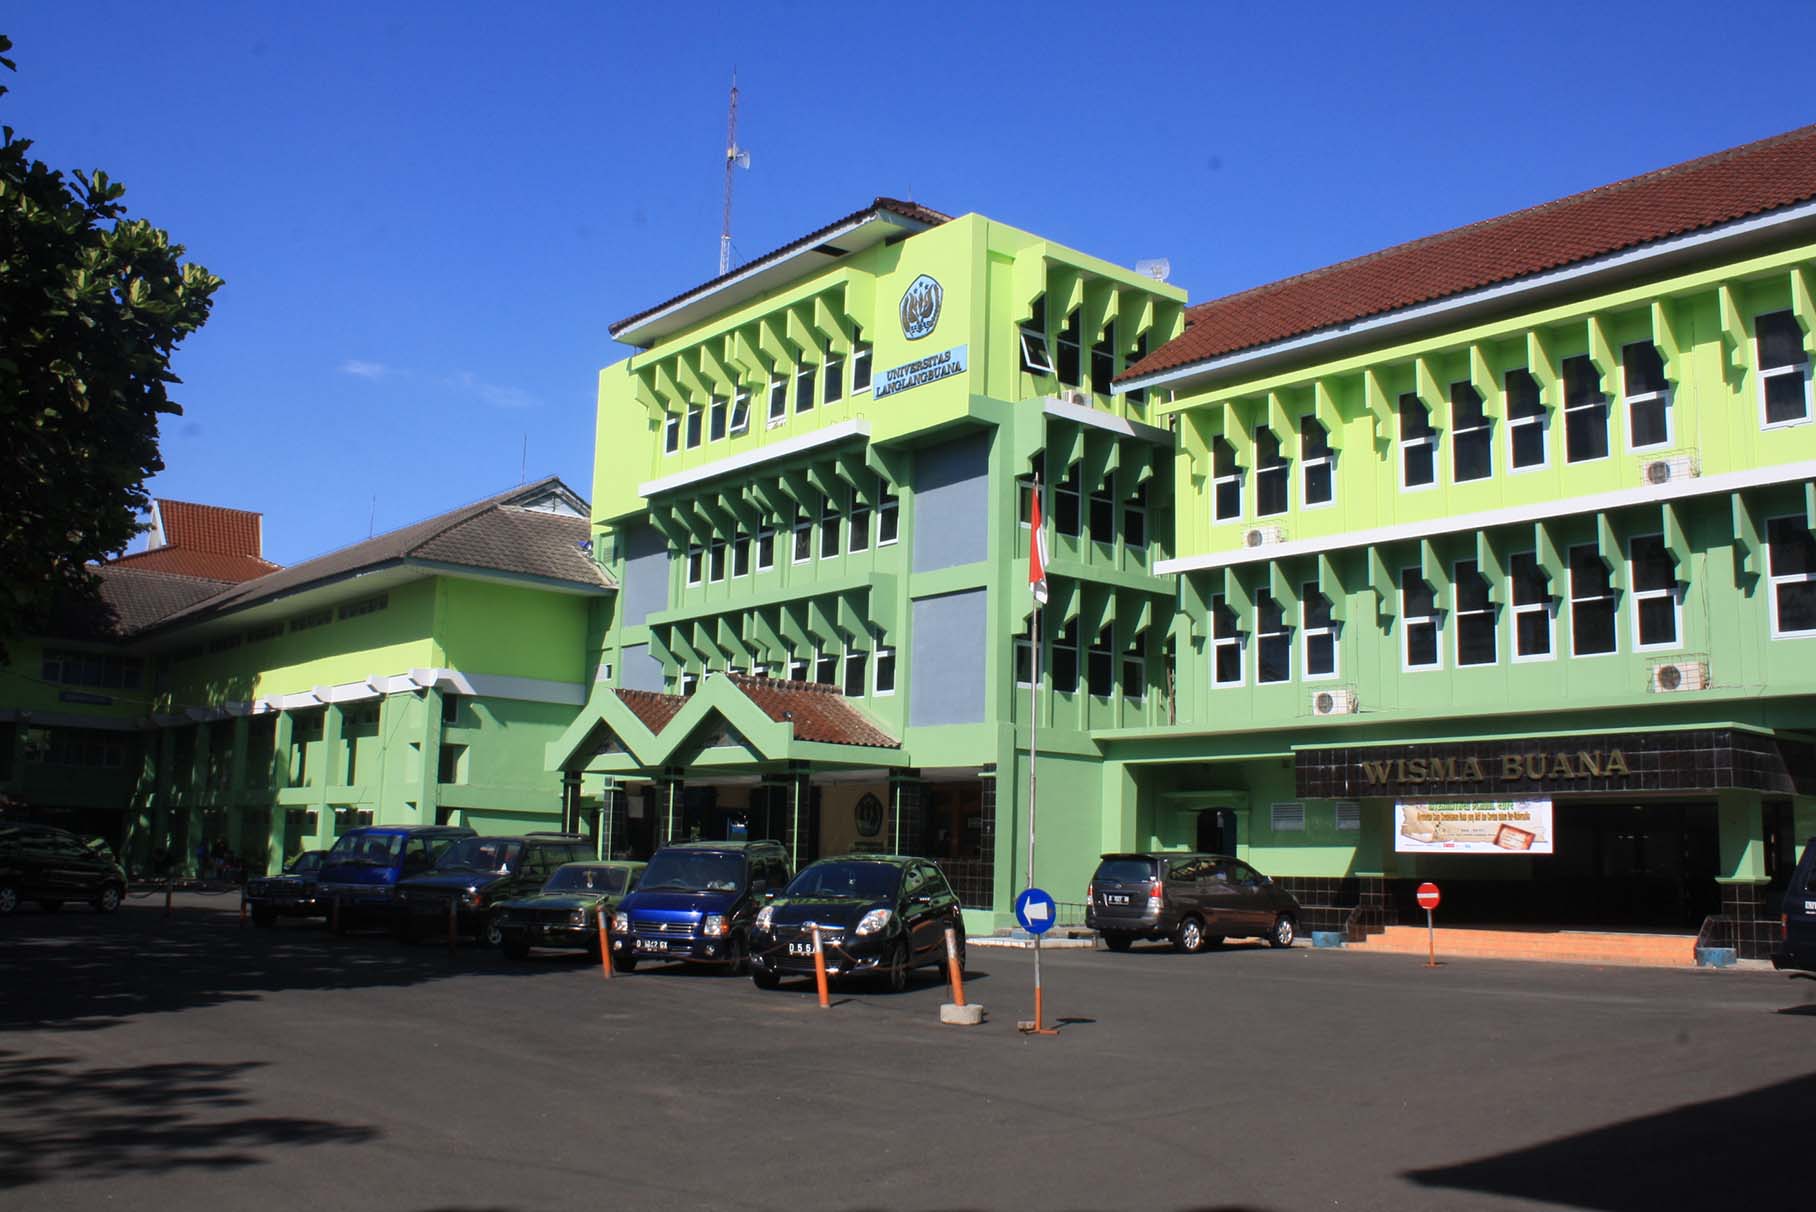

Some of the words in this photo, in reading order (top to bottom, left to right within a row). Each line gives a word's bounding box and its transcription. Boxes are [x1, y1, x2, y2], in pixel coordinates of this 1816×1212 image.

[876, 361, 962, 398] LANGLANGBUANA
[886, 351, 951, 381] UNIVERSITAS
[1363, 756, 1485, 786] WISMA
[1501, 749, 1631, 780] BUANA
